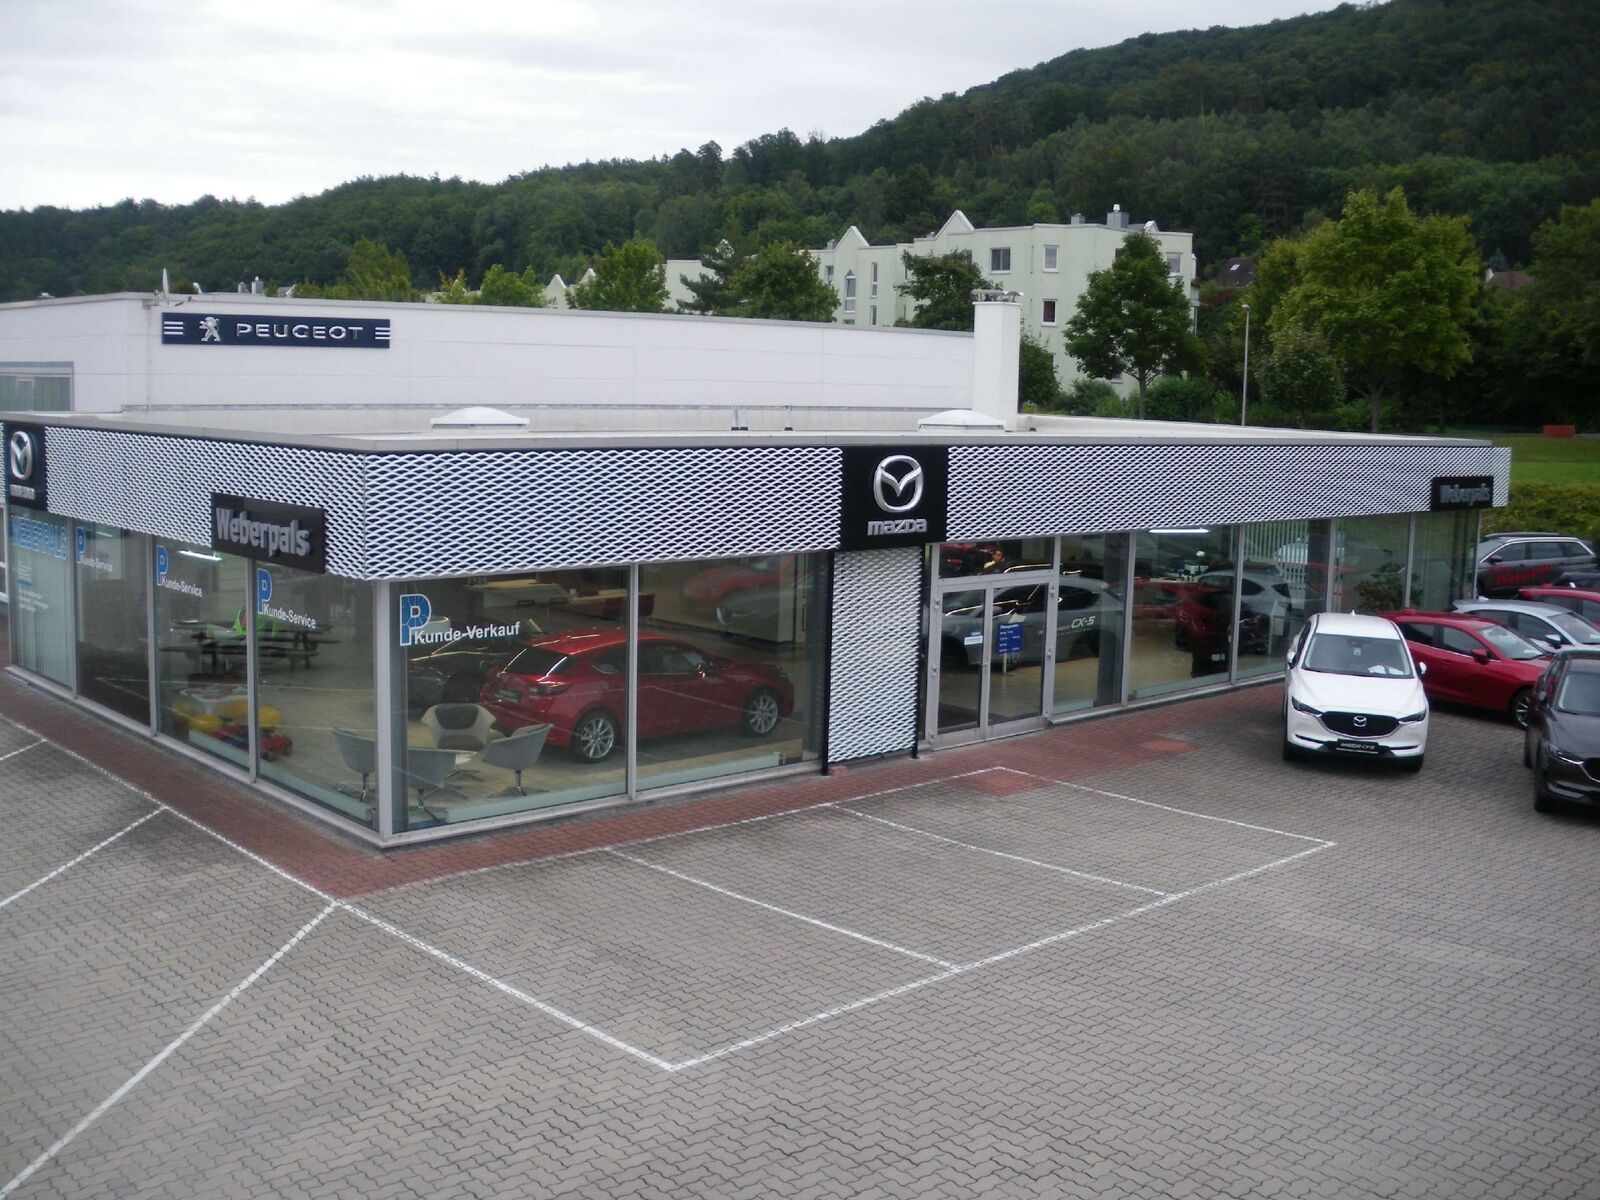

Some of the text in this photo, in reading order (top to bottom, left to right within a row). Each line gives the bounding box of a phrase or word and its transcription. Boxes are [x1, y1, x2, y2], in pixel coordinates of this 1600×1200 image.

[237, 323, 363, 340] PEUGEOT
[216, 507, 311, 557] Weberpals
[156, 545, 168, 586] P
[161, 576, 203, 598] Kunde-Service
[257, 568, 272, 614] P
[264, 603, 317, 630] Kunde-Service
[399, 593, 432, 646] P
[414, 621, 521, 645] Kunde-Verkauf
